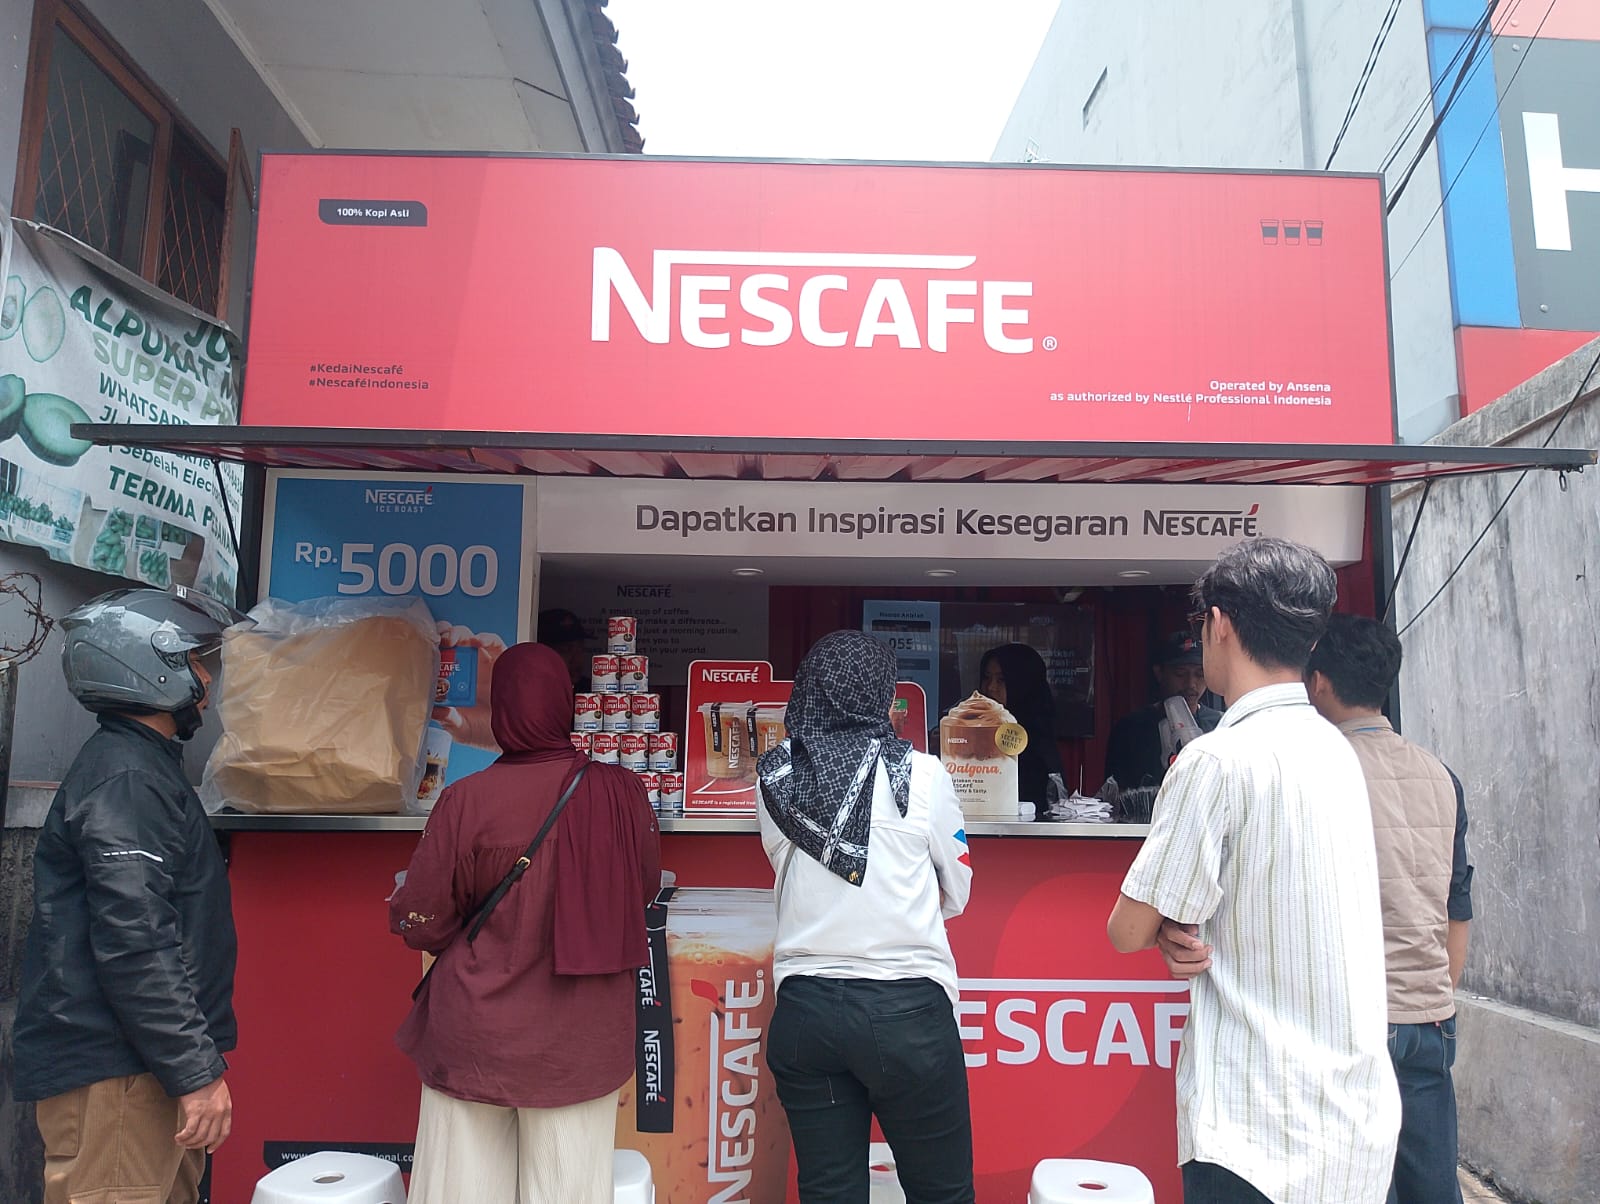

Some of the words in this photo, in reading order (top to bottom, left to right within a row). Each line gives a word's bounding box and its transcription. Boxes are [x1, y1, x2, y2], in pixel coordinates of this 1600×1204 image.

[336, 207, 363, 217] 100%
[365, 207, 387, 219] Kopi
[389, 207, 410, 218] Asli
[70, 285, 215, 387] ALPUKAT
[92, 331, 197, 412] SUPER
[309, 362, 404, 375] #KedaiNescafé
[309, 377, 430, 391] #NescaféIndonesia
[1210, 379, 1266, 394] Operated
[1268, 380, 1284, 395] by
[1286, 382, 1332, 393] Ansena
[1050, 393, 1064, 402] as
[1066, 390, 1132, 403] authorized
[1134, 392, 1150, 405] by
[1153, 391, 1193, 404] Nestlé
[1195, 393, 1270, 406] Professional
[1273, 394, 1332, 407] Indonesia
[109, 465, 196, 522] TERIMA
[636, 504, 797, 538] Dapatkan
[808, 506, 944, 540] Inspirasi
[955, 509, 1128, 542] Kesegaran
[645, 617, 667, 625] make
[669, 627, 704, 636] morning
[652, 637, 669, 645] you
[660, 648, 678, 656] your
[1001, 733, 1023, 744] SECRET
[1001, 739, 1019, 749] MENU
